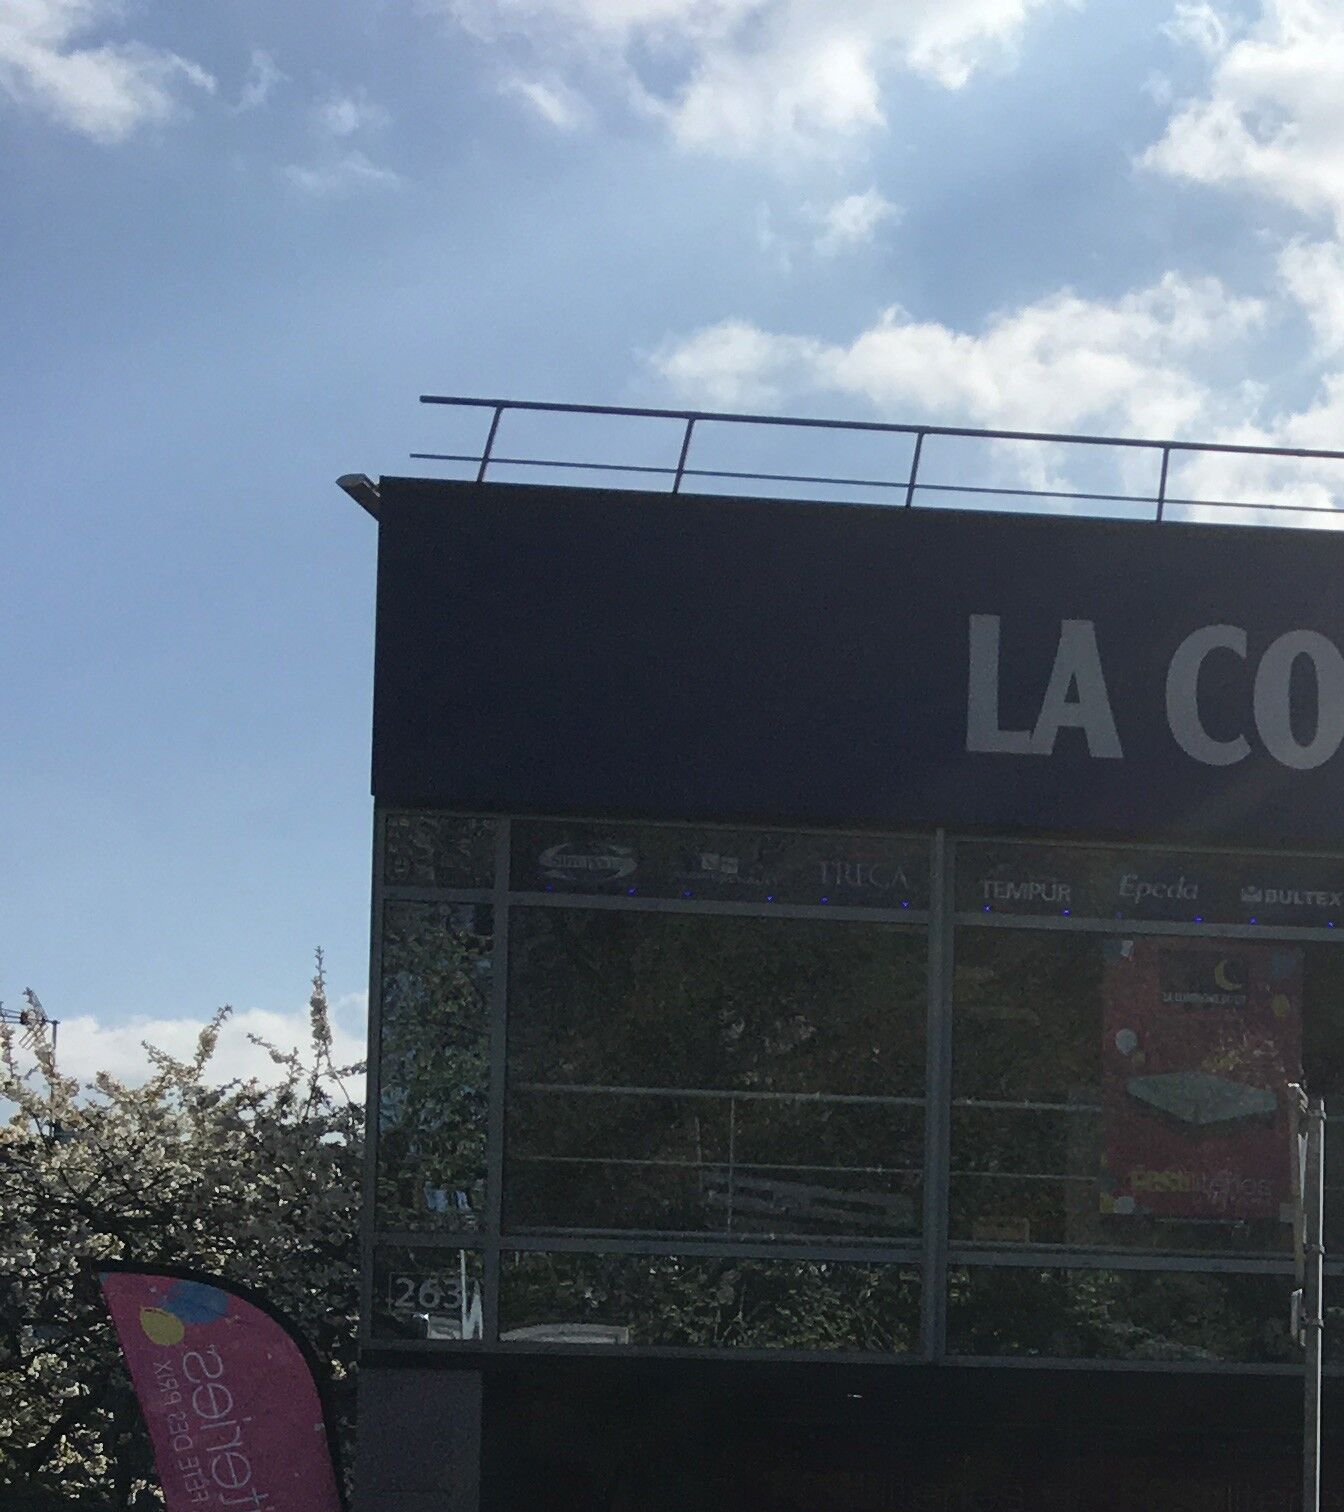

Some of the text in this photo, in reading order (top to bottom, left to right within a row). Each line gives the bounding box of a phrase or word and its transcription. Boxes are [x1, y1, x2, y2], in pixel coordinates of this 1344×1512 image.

[967, 613, 1123, 759] LA
[981, 878, 1072, 903] TEMPUR
[1118, 873, 1199, 904] Epeda
[1264, 888, 1344, 907] BULTEX
[394, 1276, 464, 1310] 263
